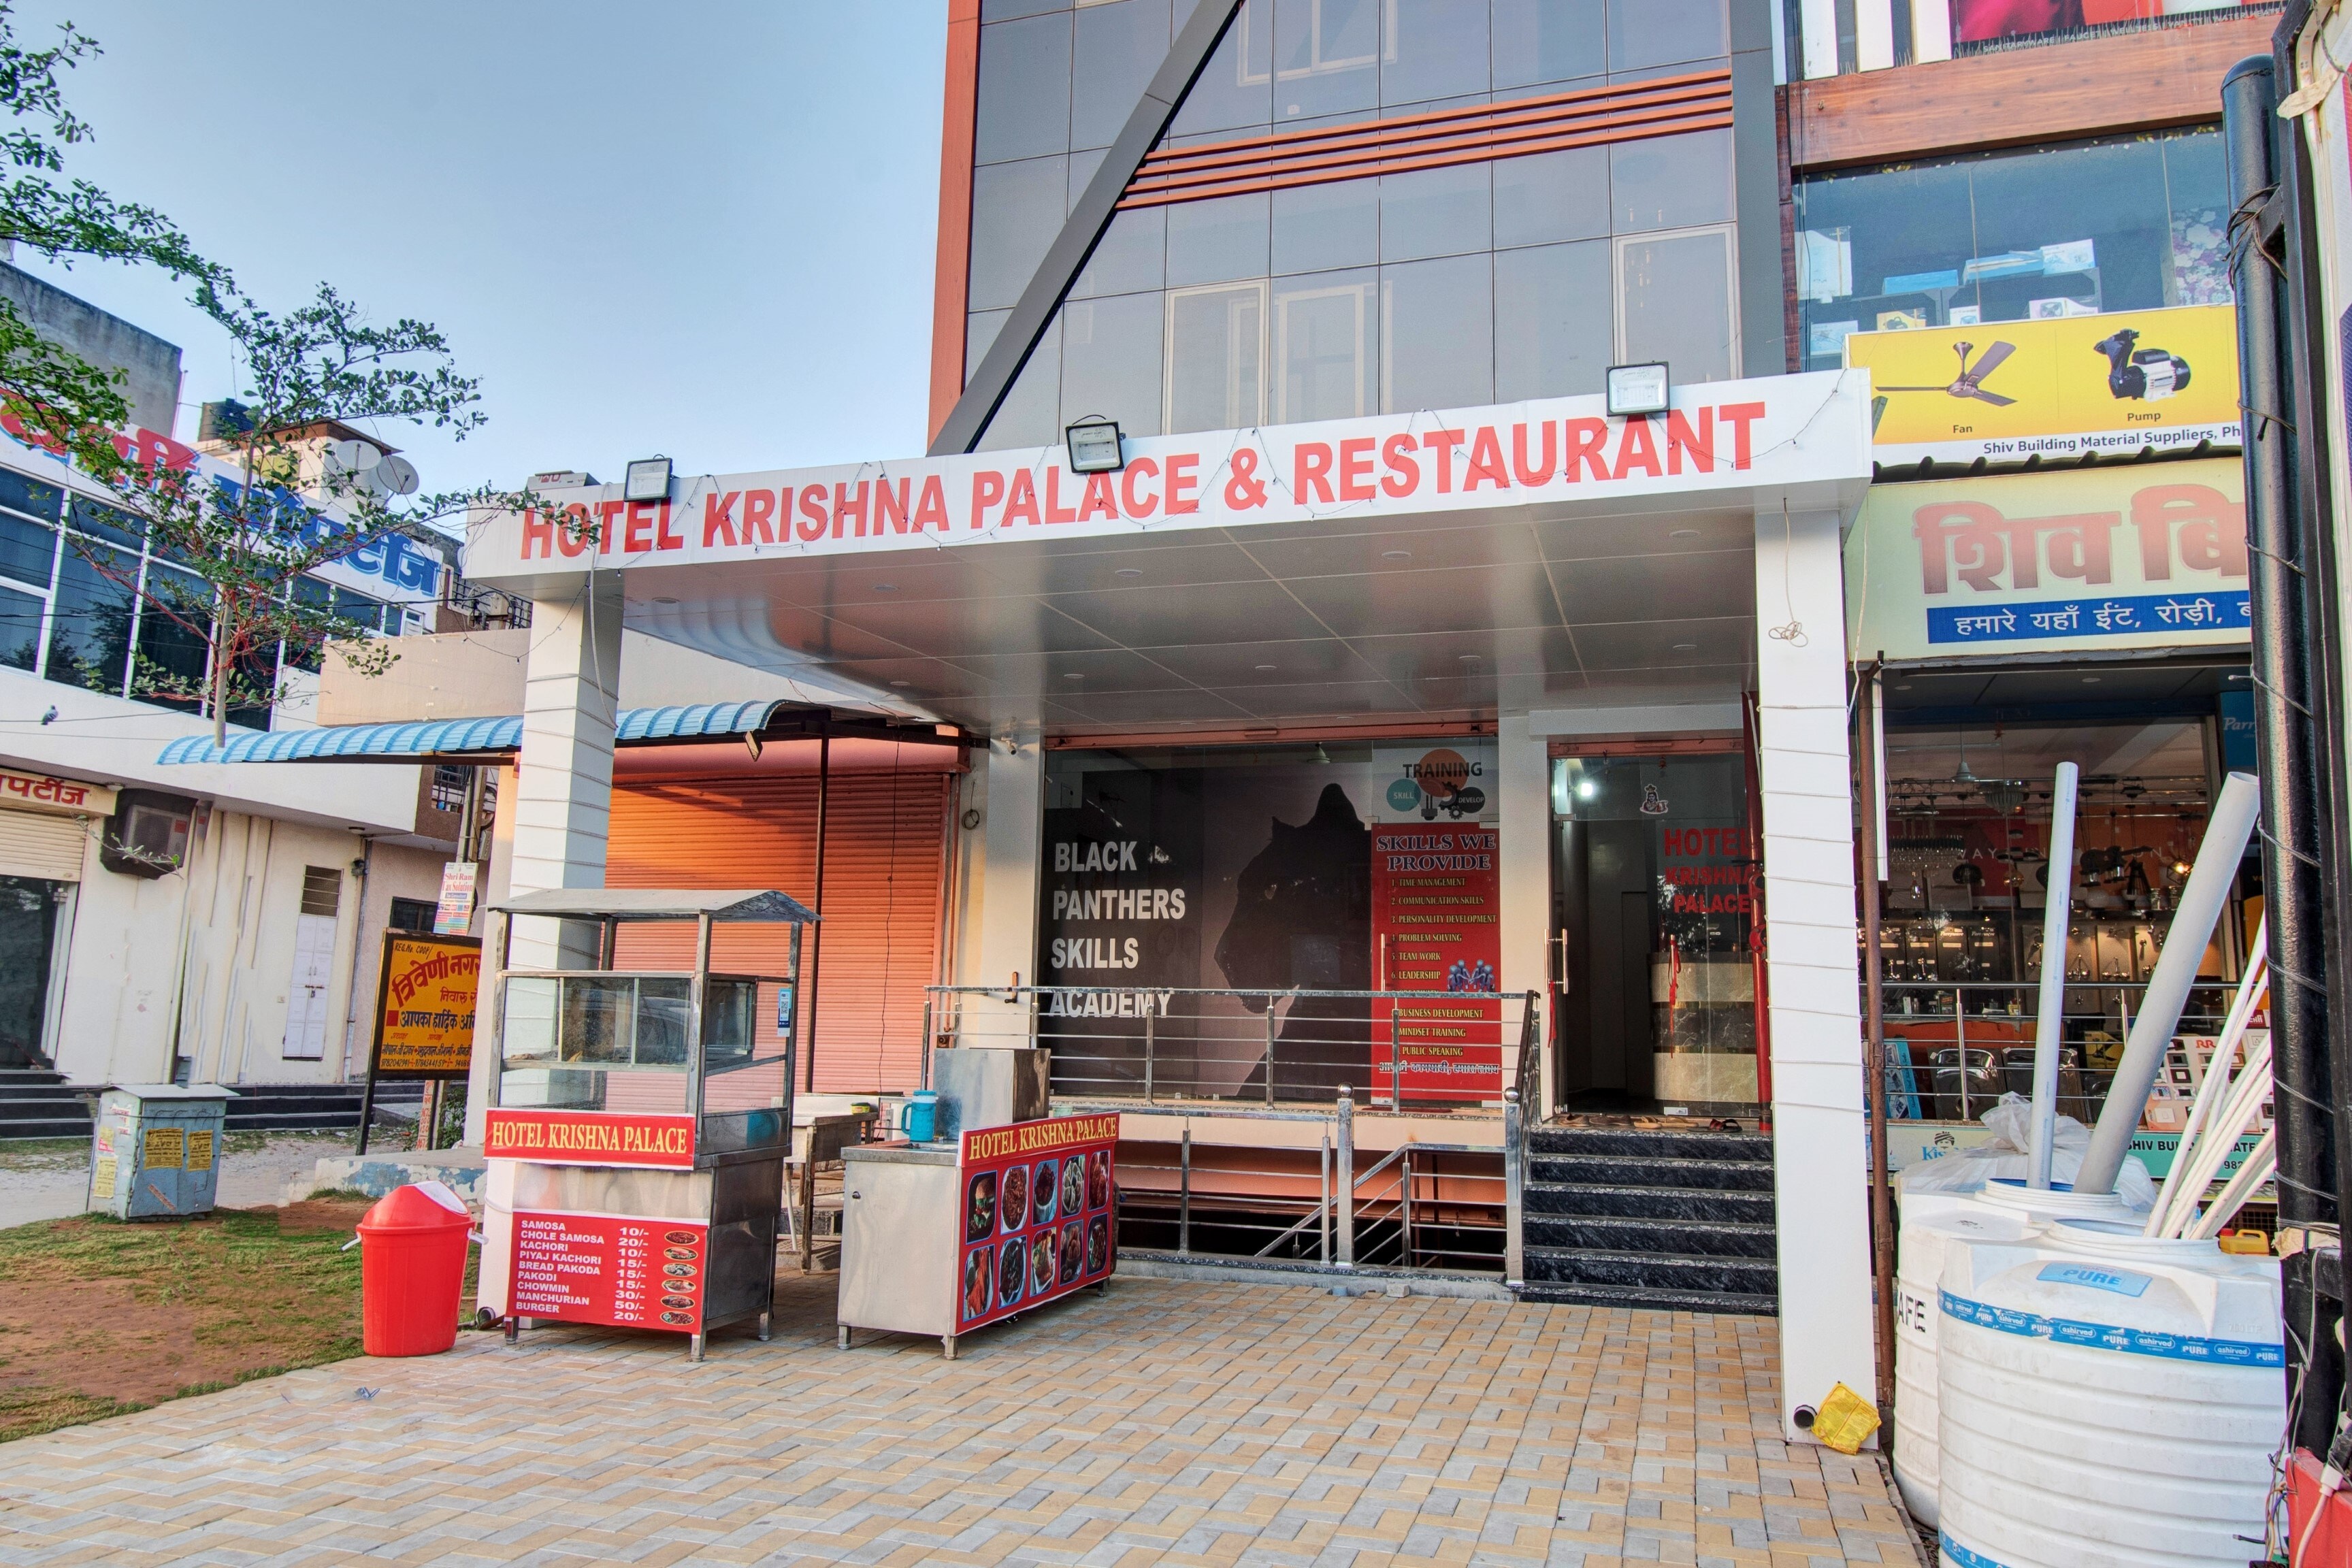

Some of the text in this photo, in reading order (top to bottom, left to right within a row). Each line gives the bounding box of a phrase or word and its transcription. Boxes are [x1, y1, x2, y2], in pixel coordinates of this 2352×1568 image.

[2212, 12, 2245, 22] WATER
[2127, 412, 2161, 421] Pump
[1953, 424, 1973, 434] Fan
[1984, 442, 2014, 454] Shiv
[2018, 438, 2076, 453] Building
[2081, 434, 2140, 448] Material
[2144, 426, 2218, 443] Suppliers,
[520, 402, 1765, 559] HOTEL KRISHNA PALACE & RESTAURANT
[1913, 502, 2122, 595] शिव
[1955, 608, 2016, 636] हमारे
[2030, 604, 2080, 631] यहाँ
[2223, 717, 2257, 731] Parr
[1403, 762, 1482, 778] TRAINING
[1393, 791, 1415, 800] SKILL
[1377, 834, 1497, 851] SKILLS WE
[1664, 828, 1750, 857] HOTEL
[1055, 841, 1137, 872] BLACK
[1387, 854, 1491, 872] PROVIDE
[1399, 878, 1416, 886] TIME
[1417, 877, 1466, 886] MANAGEMENT
[1665, 865, 1752, 885] KRISHNA
[442, 881, 473, 892] Tax Solution
[1053, 888, 1186, 919] PANTHERS
[1399, 896, 1459, 905] COMMUNICATION
[1460, 896, 1484, 904] SKILLS
[1674, 893, 1751, 914] PALACE
[1399, 915, 1444, 924] PERSONALITY
[1446, 915, 1497, 923] DEVELOPMENT
[1399, 934, 1431, 942] PROBLEM
[1433, 934, 1462, 942] SOLVING
[1051, 937, 1139, 969] SKILLS
[1399, 952, 1418, 960] TEAM
[1420, 952, 1441, 960] WORK
[1399, 971, 1441, 979] LEADERSHIP
[1049, 990, 1171, 1018] ACADEMY
[400, 1011, 432, 1028] आपका
[1399, 1009, 1431, 1017] BUSINESS
[1433, 1009, 1484, 1018] DEVELOPMENT
[1399, 1028, 1466, 1036] MINDSET TRAINING
[1403, 1047, 1463, 1056] PUBLIC SPEAKING
[491, 1121, 687, 1154] HOTEL KRISHNA PALACE
[969, 1117, 1117, 1160] HOTEL KRISHNA PALACE
[521, 1220, 649, 1237] SAMOSA 10/-
[521, 1230, 649, 1247] CHOLE SAMOSA 20/-
[520, 1240, 648, 1258] KACHORI 10/-
[519, 1250, 647, 1269] PIYAJ KACHORI 15/-
[519, 1260, 647, 1279] BREAD PAKODA 15/-
[2063, 1269, 2122, 1286] PURE
[518, 1271, 646, 1290] PAKODI 15/-
[517, 1281, 645, 1300] CHOWMIN 30/-
[517, 1291, 644, 1311] MANCHURIAN 50/-
[516, 1301, 644, 1321] BURGER 20/-
[1976, 1311, 1994, 1322] PURE
[1998, 1314, 2025, 1326] ashirvad
[2031, 1323, 2053, 1334] PURE
[2061, 1327, 2094, 1337] ashirvad
[2102, 1335, 2129, 1345] PURE
[2138, 1337, 2172, 1348] ashirvad
[2181, 1345, 2209, 1355] PURE
[2217, 1346, 2249, 1356] ashirvad
[2255, 1352, 2280, 1362] PURE
